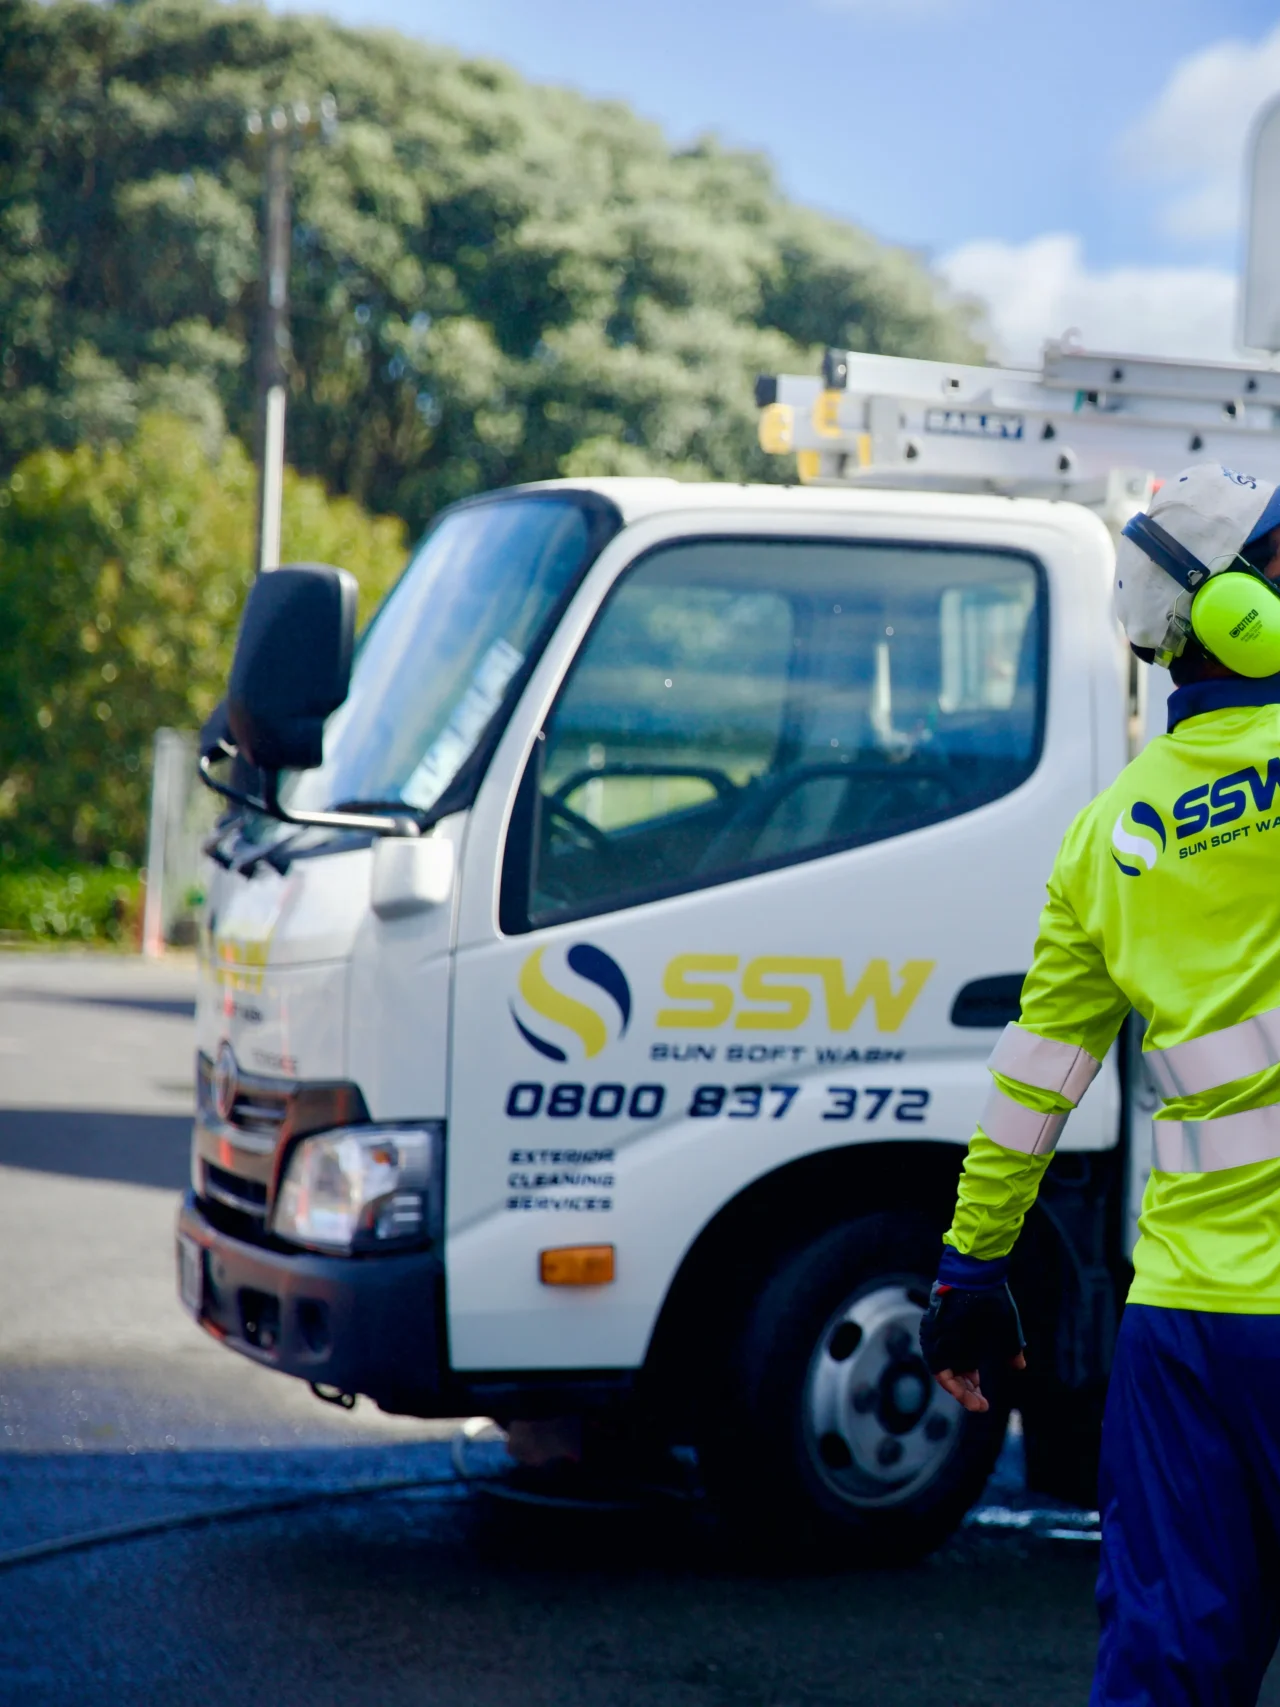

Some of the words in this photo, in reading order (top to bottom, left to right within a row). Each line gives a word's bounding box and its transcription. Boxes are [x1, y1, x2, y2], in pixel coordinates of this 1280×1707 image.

[1236, 608, 1259, 632] CITECO
[1179, 838, 1208, 859] SUN
[1211, 825, 1251, 848] SOFT
[655, 953, 936, 1033] SSW
[651, 1043, 717, 1062] SUN
[725, 1044, 807, 1063] SOFT
[816, 1045, 905, 1065] WASH
[506, 1081, 666, 1119] 0800
[687, 1083, 801, 1119] 837
[821, 1087, 932, 1122] 372
[509, 1148, 615, 1165] EXTERIOR
[507, 1173, 615, 1189] CLEANING
[505, 1196, 613, 1211] SERVICES
